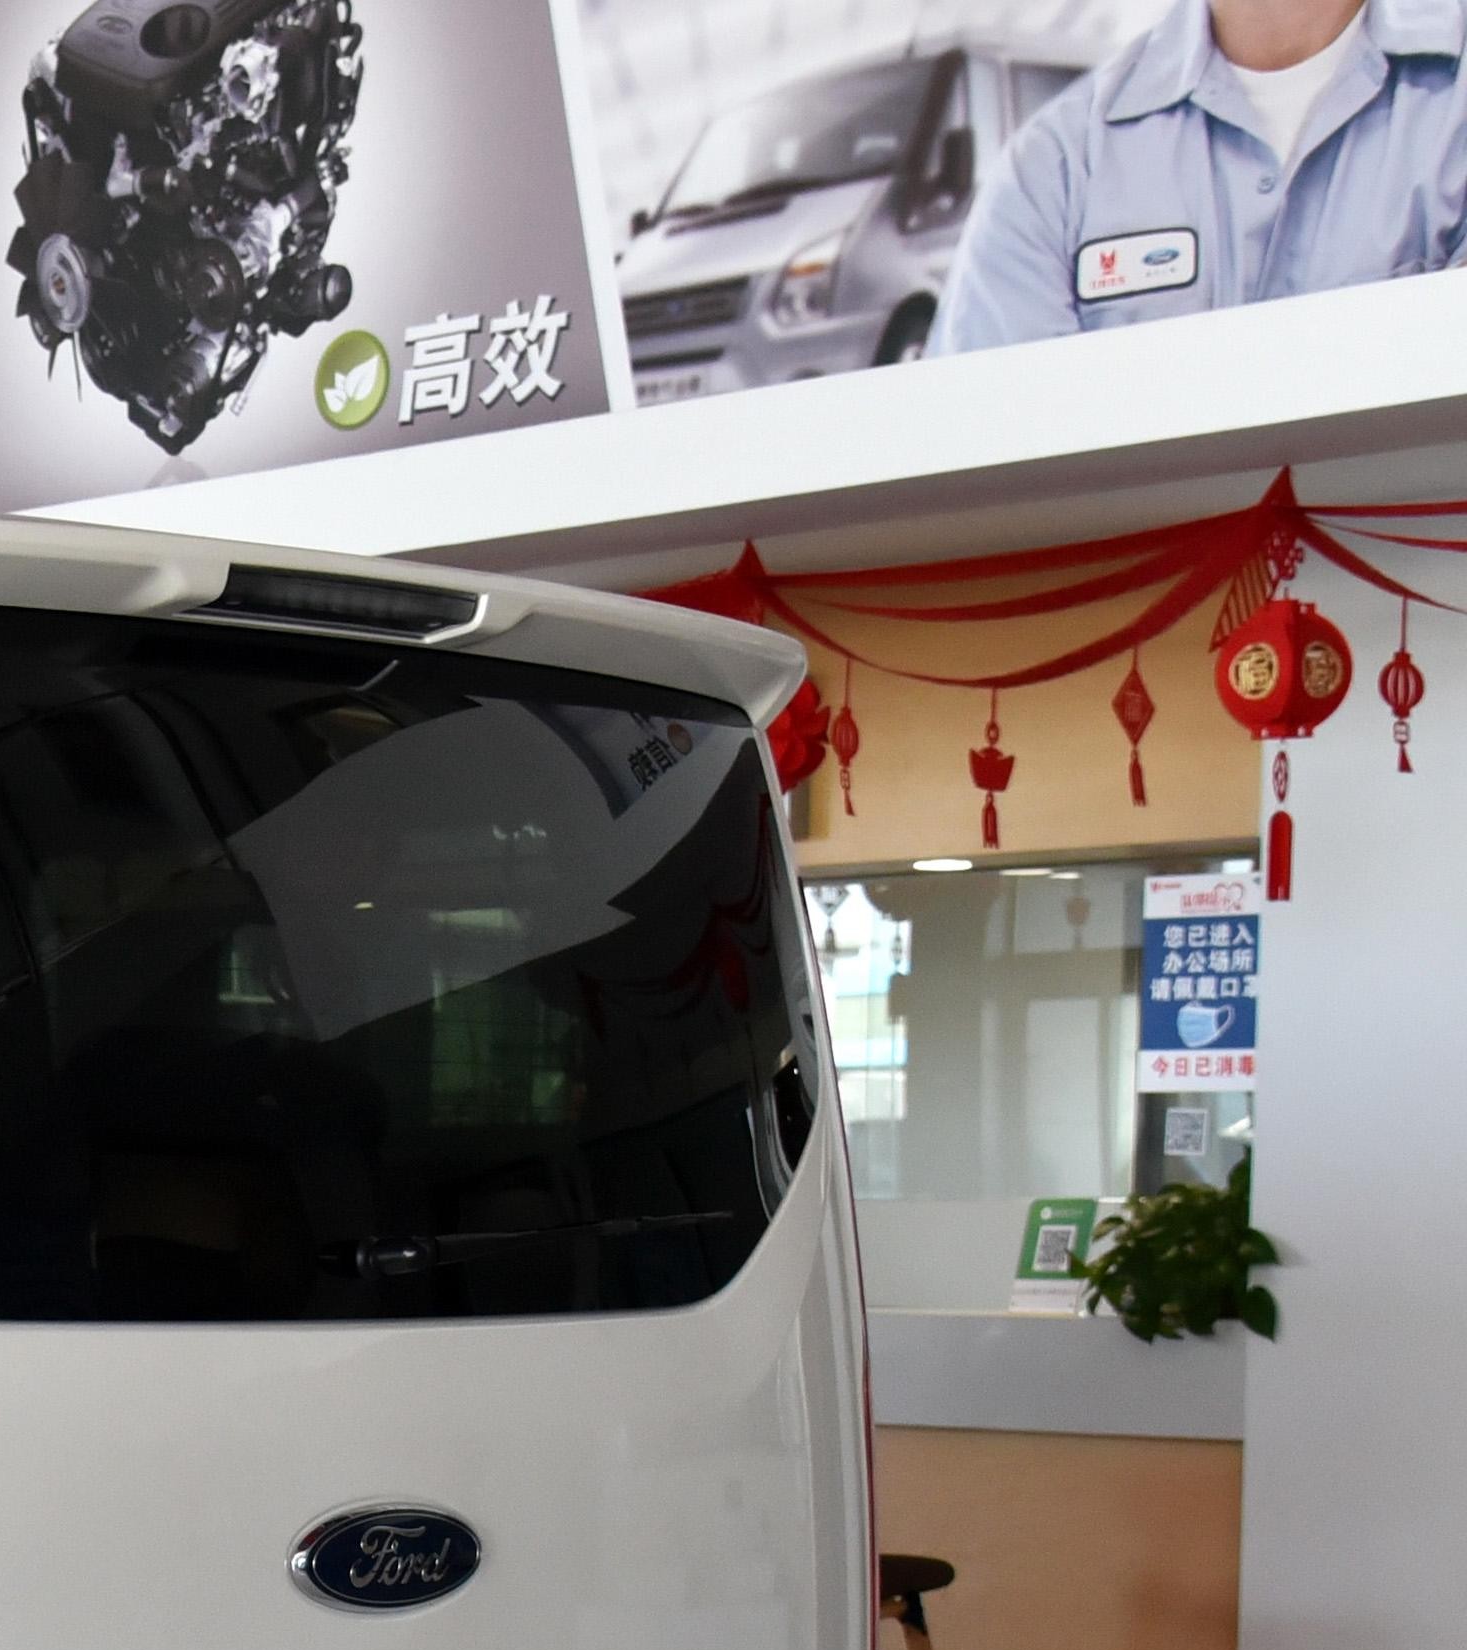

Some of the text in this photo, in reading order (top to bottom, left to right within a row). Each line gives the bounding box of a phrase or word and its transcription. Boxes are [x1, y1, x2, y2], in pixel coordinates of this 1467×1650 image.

[398, 294, 569, 424] 高效
[1163, 922, 1254, 949] 您已进入
[1163, 948, 1253, 975] 办公场所
[1152, 1054, 1255, 1078] 今日已消毒
[349, 1524, 452, 1589] Ford
